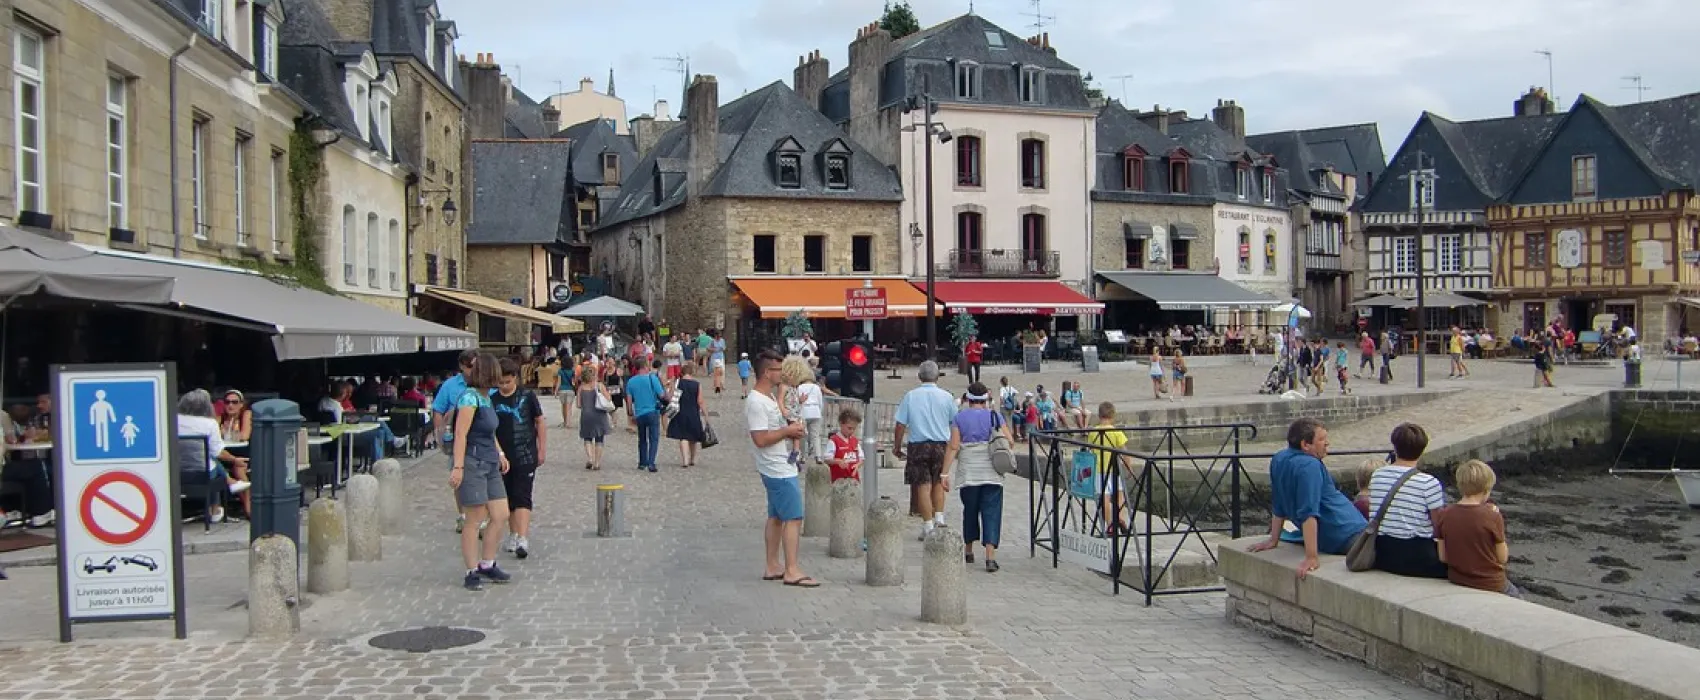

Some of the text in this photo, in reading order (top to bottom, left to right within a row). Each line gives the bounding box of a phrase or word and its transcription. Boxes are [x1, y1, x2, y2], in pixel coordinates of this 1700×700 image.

[1217, 210, 1249, 221] RESTAURANT
[76, 586, 165, 596] Livraison autorisée
[89, 595, 154, 608] jusqu'à 11h00
